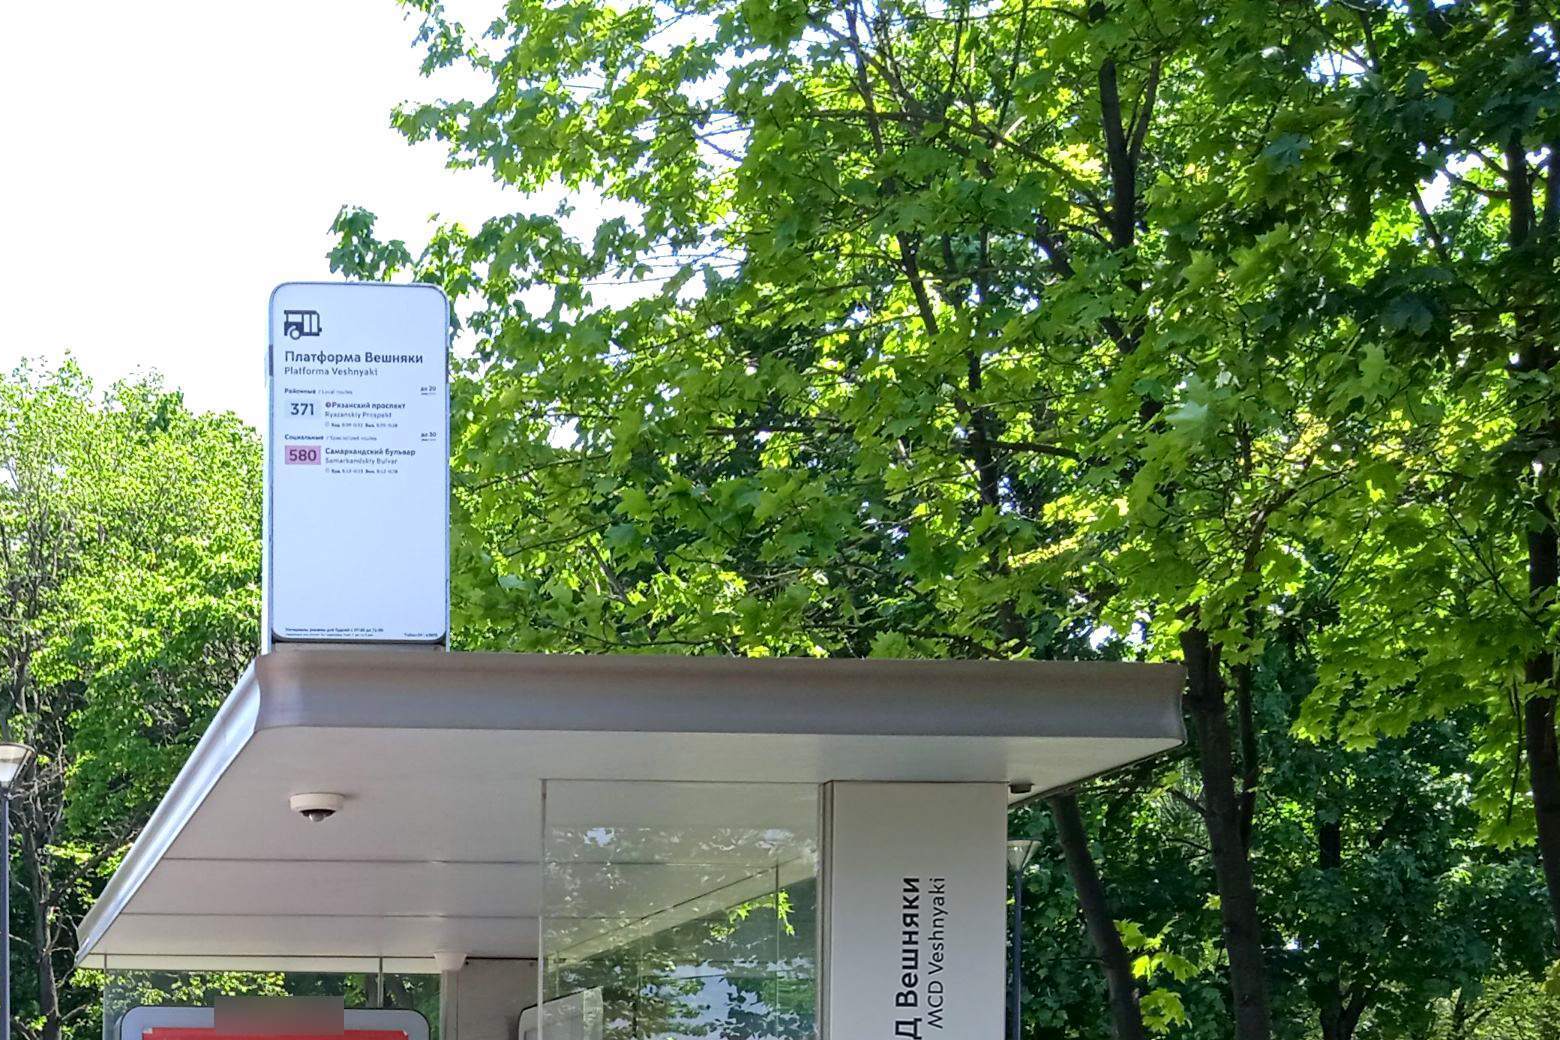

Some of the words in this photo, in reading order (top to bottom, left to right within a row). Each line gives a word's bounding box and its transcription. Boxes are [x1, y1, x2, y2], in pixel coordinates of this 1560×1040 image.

[285, 350, 361, 365] Платформа
[365, 351, 424, 364] Вешняки
[284, 367, 330, 375] Platforma
[332, 367, 378, 377] Veshnyaki
[291, 403, 314, 416] 371
[289, 449, 317, 462] 580
[325, 448, 384, 456] Самаркандский
[927, 877, 948, 976] Veshnyaki
[895, 877, 920, 1008] Вешняки
[927, 981, 944, 1029] MCD
